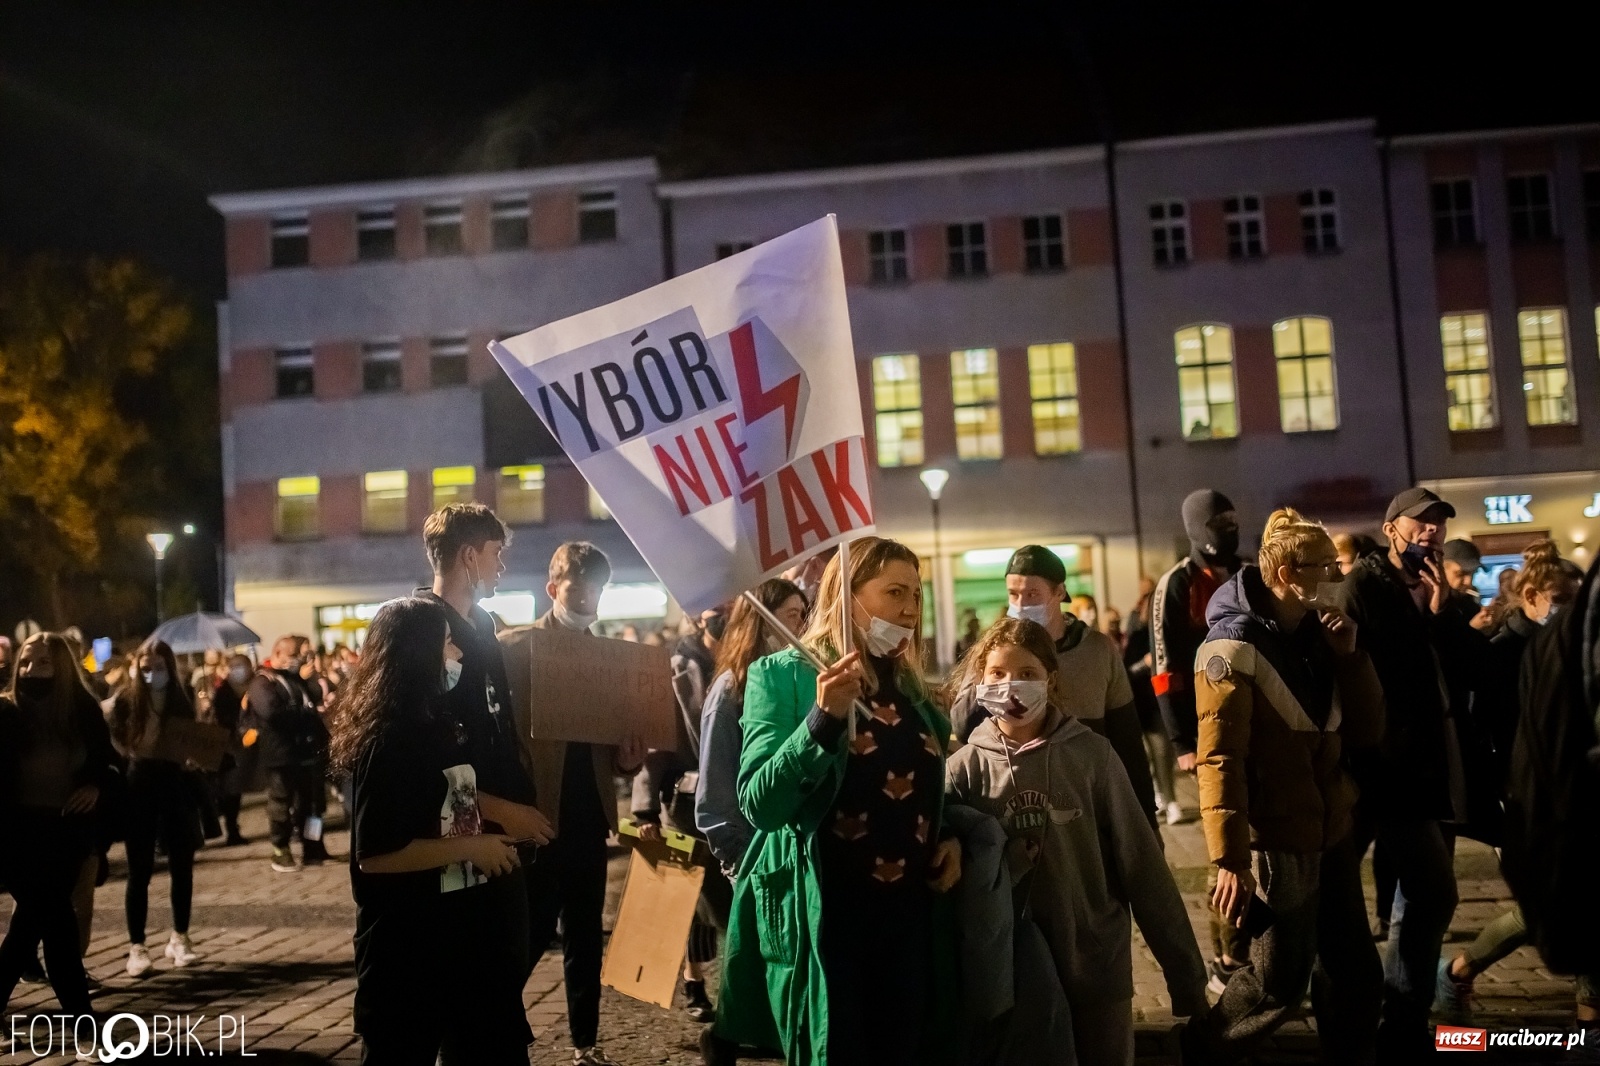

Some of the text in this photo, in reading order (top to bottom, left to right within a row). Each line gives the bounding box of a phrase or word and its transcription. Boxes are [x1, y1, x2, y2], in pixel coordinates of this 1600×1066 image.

[537, 329, 727, 453] YBÓR
[653, 412, 759, 517] NIE
[739, 436, 874, 573] ZAK
